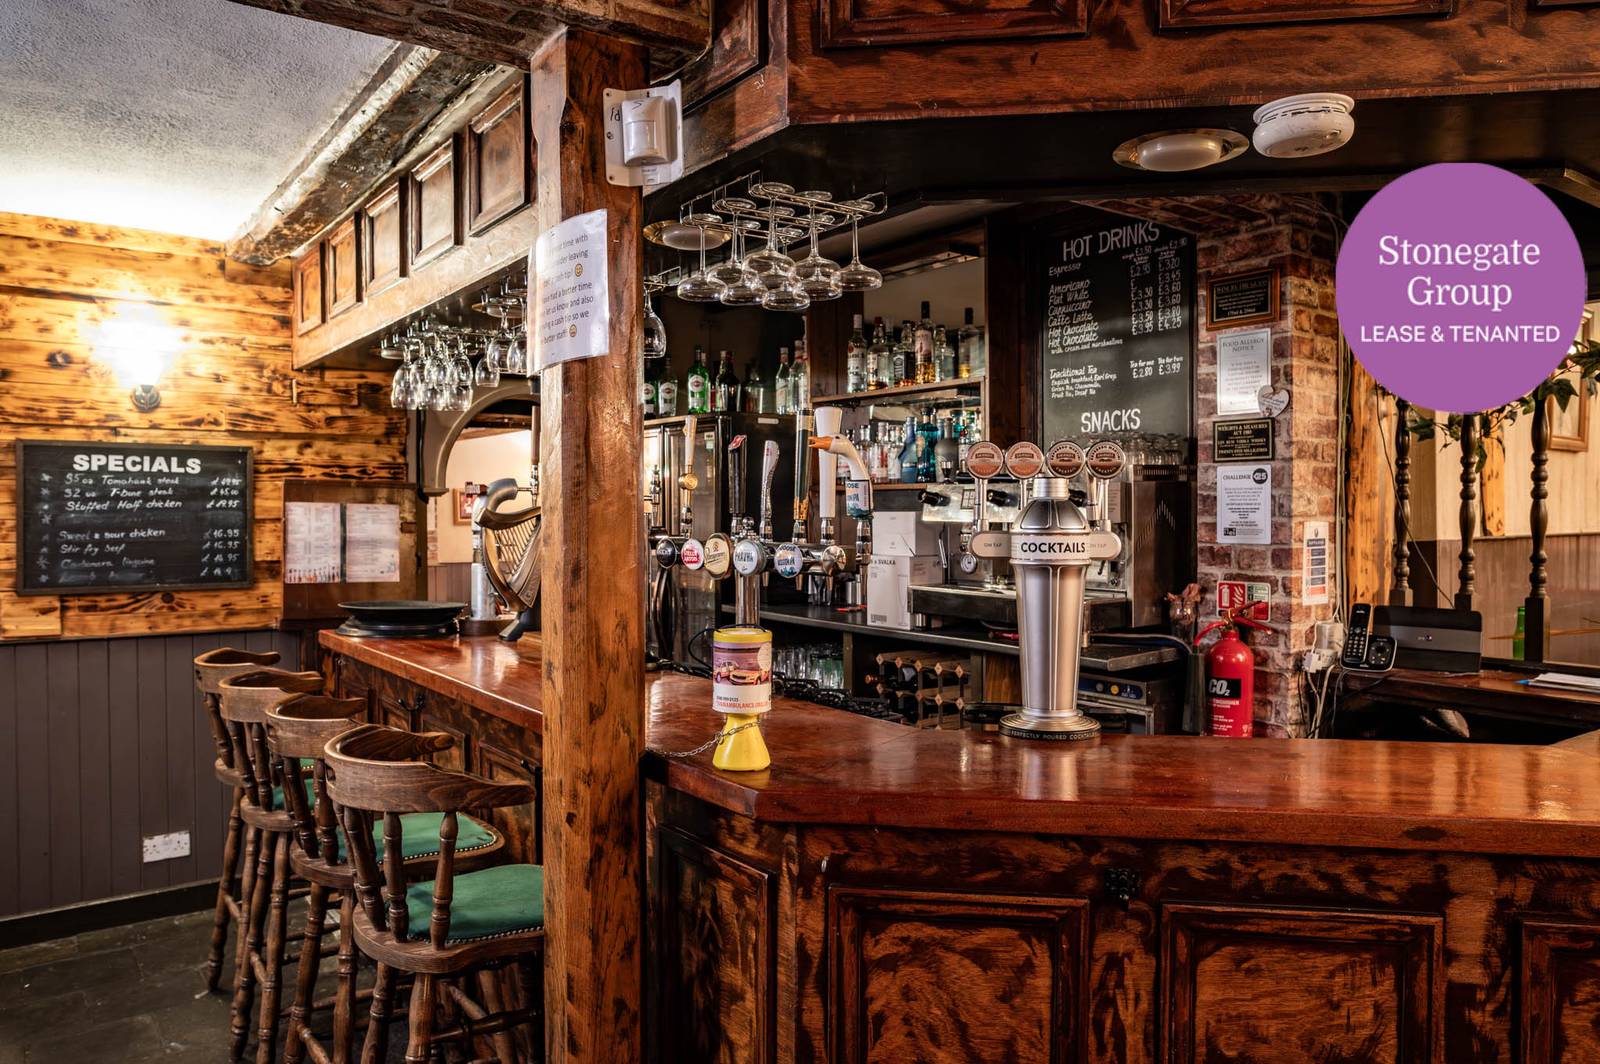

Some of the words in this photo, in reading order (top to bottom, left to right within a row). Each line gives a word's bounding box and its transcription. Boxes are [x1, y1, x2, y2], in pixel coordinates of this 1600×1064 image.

[1063, 234, 1093, 262] HOT
[1098, 222, 1159, 254] DRINKS
[1048, 262, 1082, 277] Espresso
[578, 282, 592, 292] time
[1049, 280, 1091, 296] Americano
[581, 296, 594, 305] also
[1067, 290, 1089, 302] White
[1048, 327, 1062, 340] Hot
[1063, 321, 1099, 336] Chocolate
[1048, 337, 1062, 349] Hot
[1063, 331, 1099, 346] Chocolate
[1087, 364, 1098, 374] Tea
[1081, 408, 1141, 433] SNACKS
[73, 453, 201, 475] SPECIALS
[65, 501, 110, 513] Stuffed
[117, 500, 143, 513] Half
[146, 499, 183, 509] chicken
[129, 528, 166, 538] chicken
[60, 544, 80, 554] Stir
[83, 544, 100, 556] fry
[1020, 541, 1087, 554] COCKTAILS
